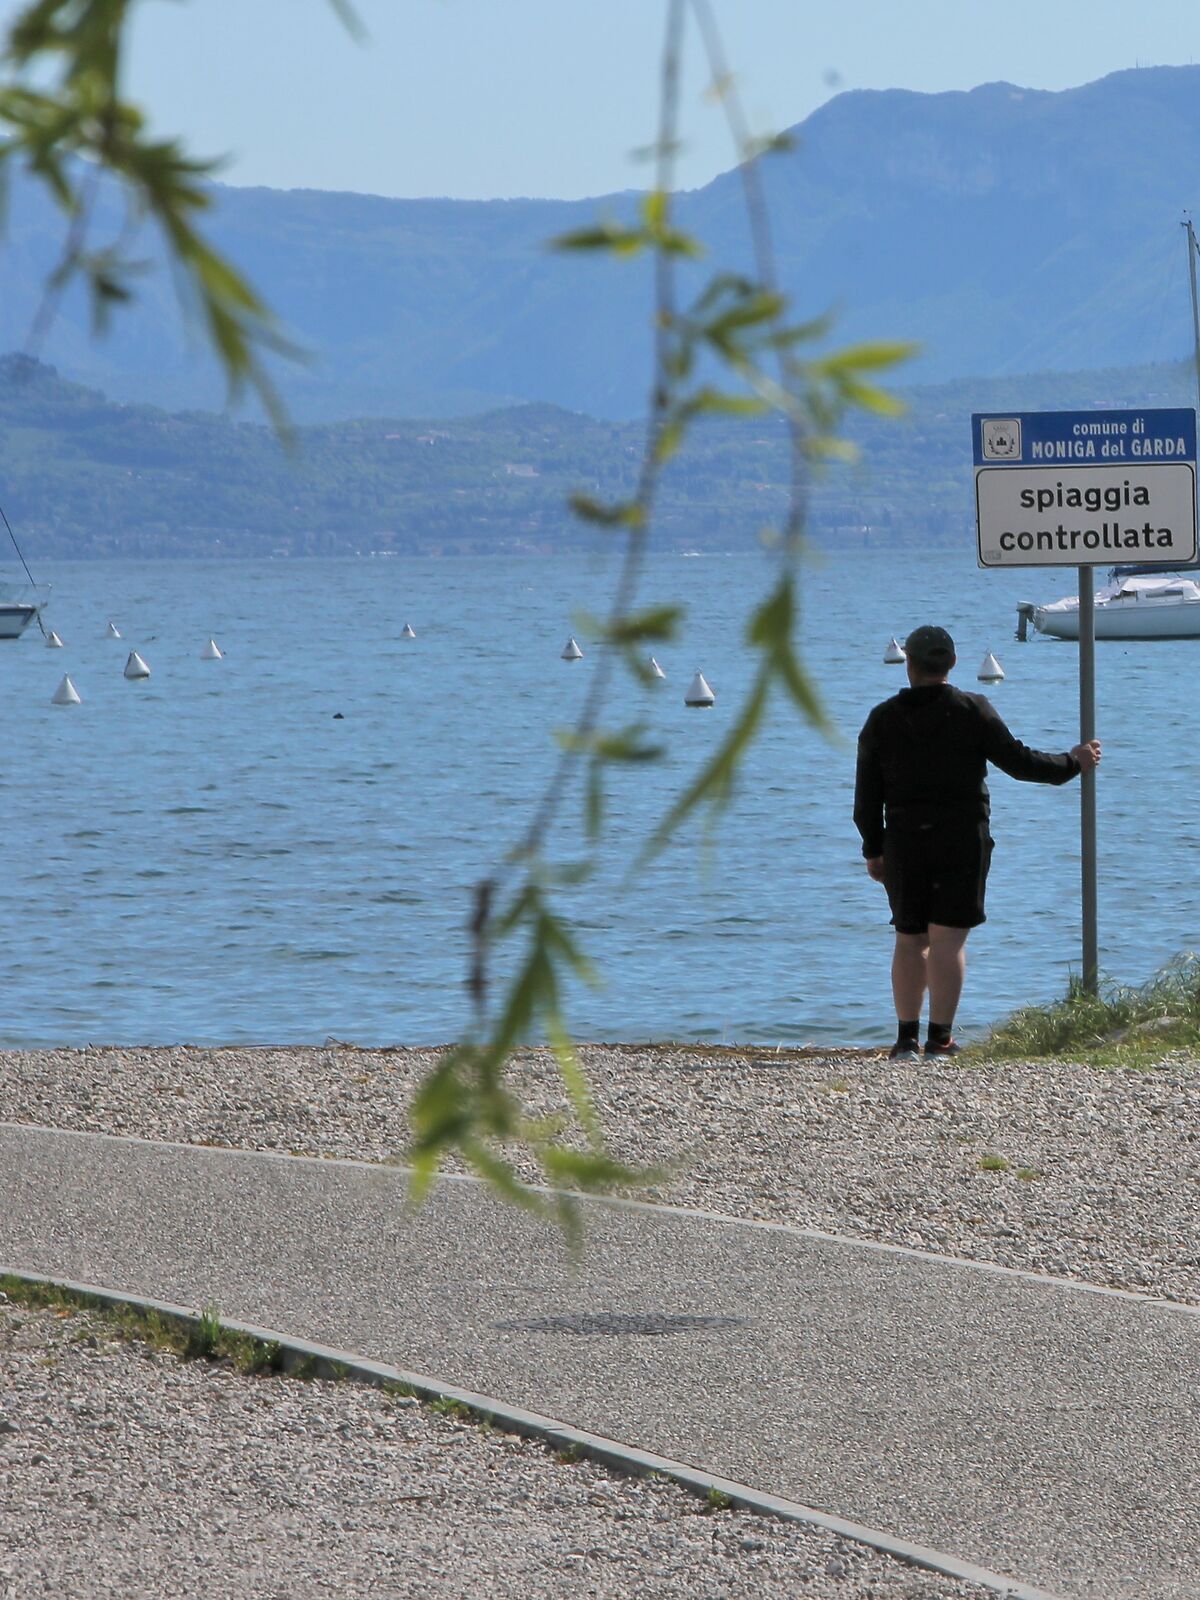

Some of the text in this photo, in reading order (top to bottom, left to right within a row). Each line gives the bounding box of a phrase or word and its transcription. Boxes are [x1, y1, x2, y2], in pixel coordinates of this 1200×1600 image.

[1073, 418, 1145, 436] comune di
[1032, 438, 1187, 458] MONIGA del GARDA
[1020, 480, 1150, 513] spiaggia
[999, 523, 1173, 551] controllata
